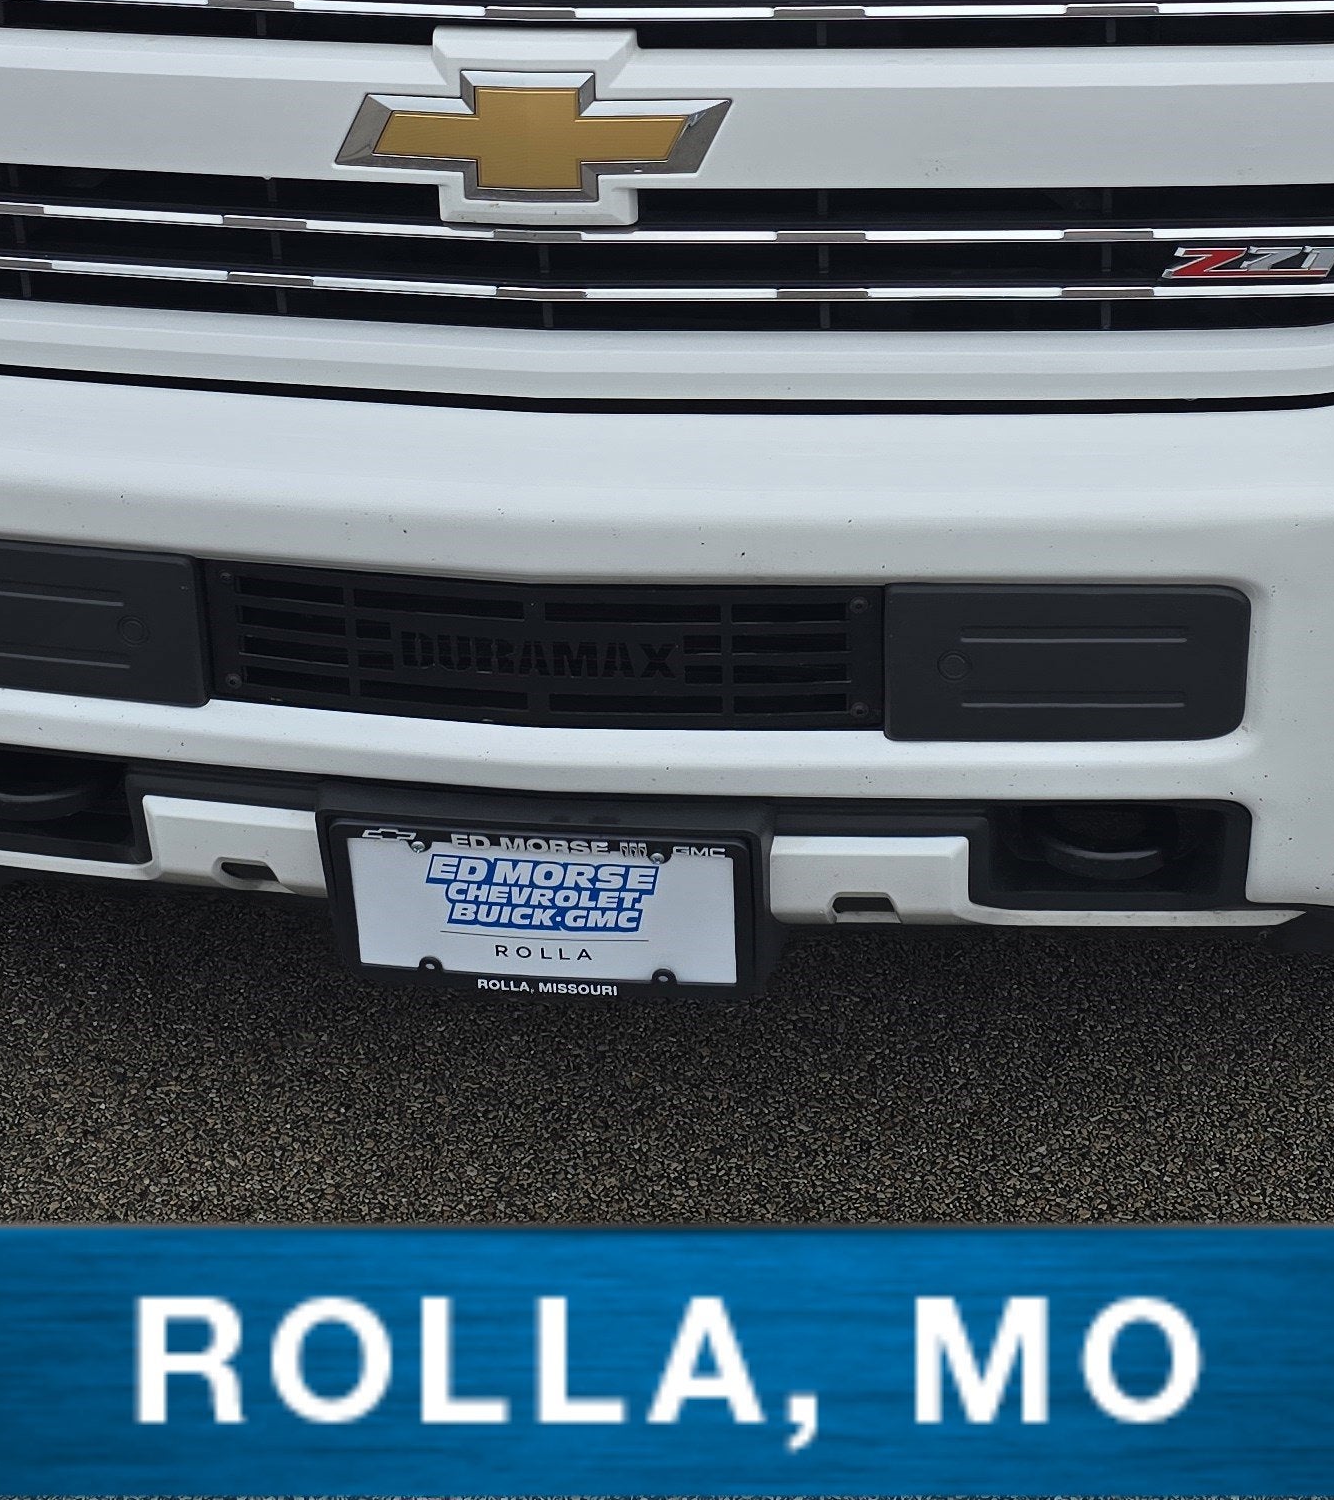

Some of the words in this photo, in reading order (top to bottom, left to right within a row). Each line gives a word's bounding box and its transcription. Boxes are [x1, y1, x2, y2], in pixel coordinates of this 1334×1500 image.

[400, 630, 677, 679] DURAMAX
[451, 834, 490, 849] ED
[499, 837, 608, 855] MORSE
[672, 846, 726, 858] GMC
[429, 856, 488, 881] ED
[493, 861, 657, 889] MORSE
[495, 944, 592, 960] ROLLA
[477, 978, 534, 994] ROLLA,
[538, 982, 618, 996] MISSOURI
